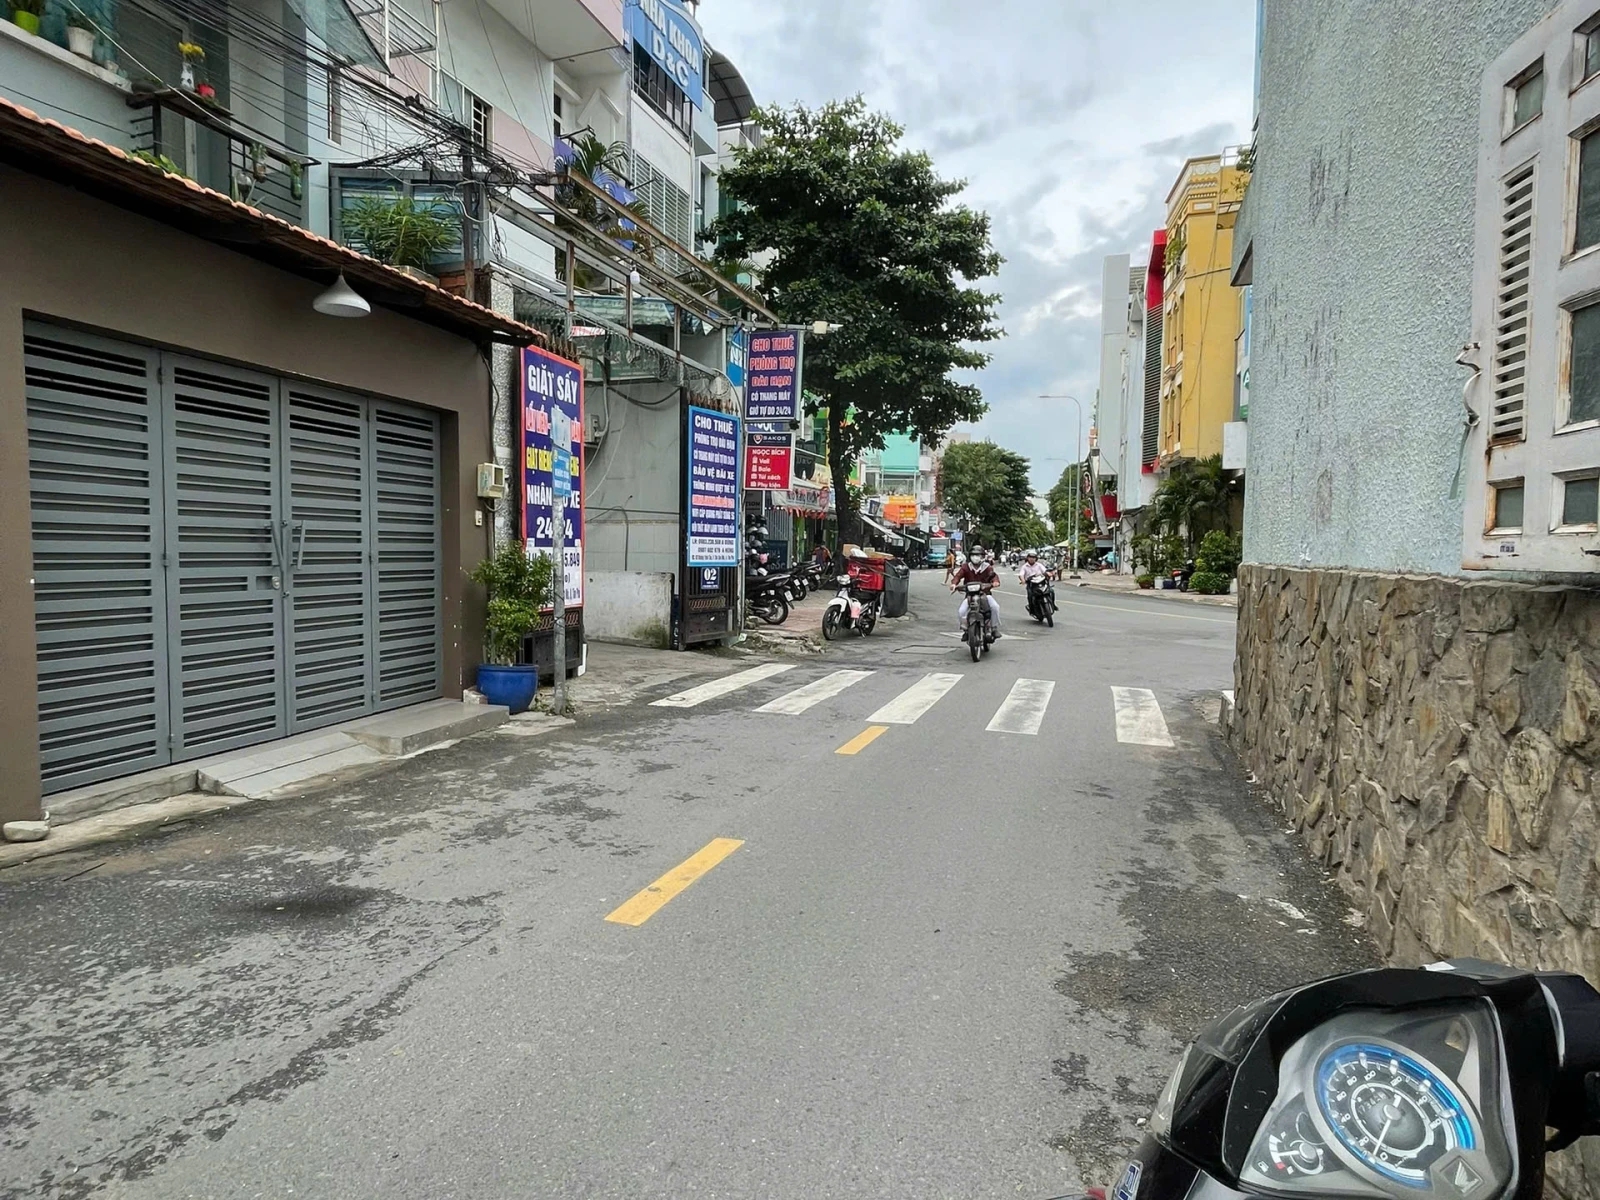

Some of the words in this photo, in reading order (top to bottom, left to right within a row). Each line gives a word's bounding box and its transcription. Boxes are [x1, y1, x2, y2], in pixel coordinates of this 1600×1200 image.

[669, 20, 700, 75] KHOA
[752, 338, 771, 352] CHO
[771, 335, 795, 352] THUÊ
[778, 356, 796, 372] TRỌ
[528, 363, 555, 401] GIẶT
[556, 371, 579, 405] SẤY
[770, 376, 792, 388] HẠN
[751, 391, 759, 402] CÓ
[760, 391, 778, 401] THANG
[778, 390, 791, 401] MÁY
[767, 406, 776, 416] DO
[776, 405, 792, 416] 24/24
[694, 415, 712, 431] CHO
[713, 419, 734, 435] THUÊ
[752, 449, 771, 457] NGỌC
[771, 448, 786, 456] BÍCH
[727, 471, 736, 481] XE
[526, 482, 553, 510] NHẬN
[570, 490, 580, 509] XE
[704, 568, 717, 581] 02
[1380, 1151, 1389, 1162] 0
